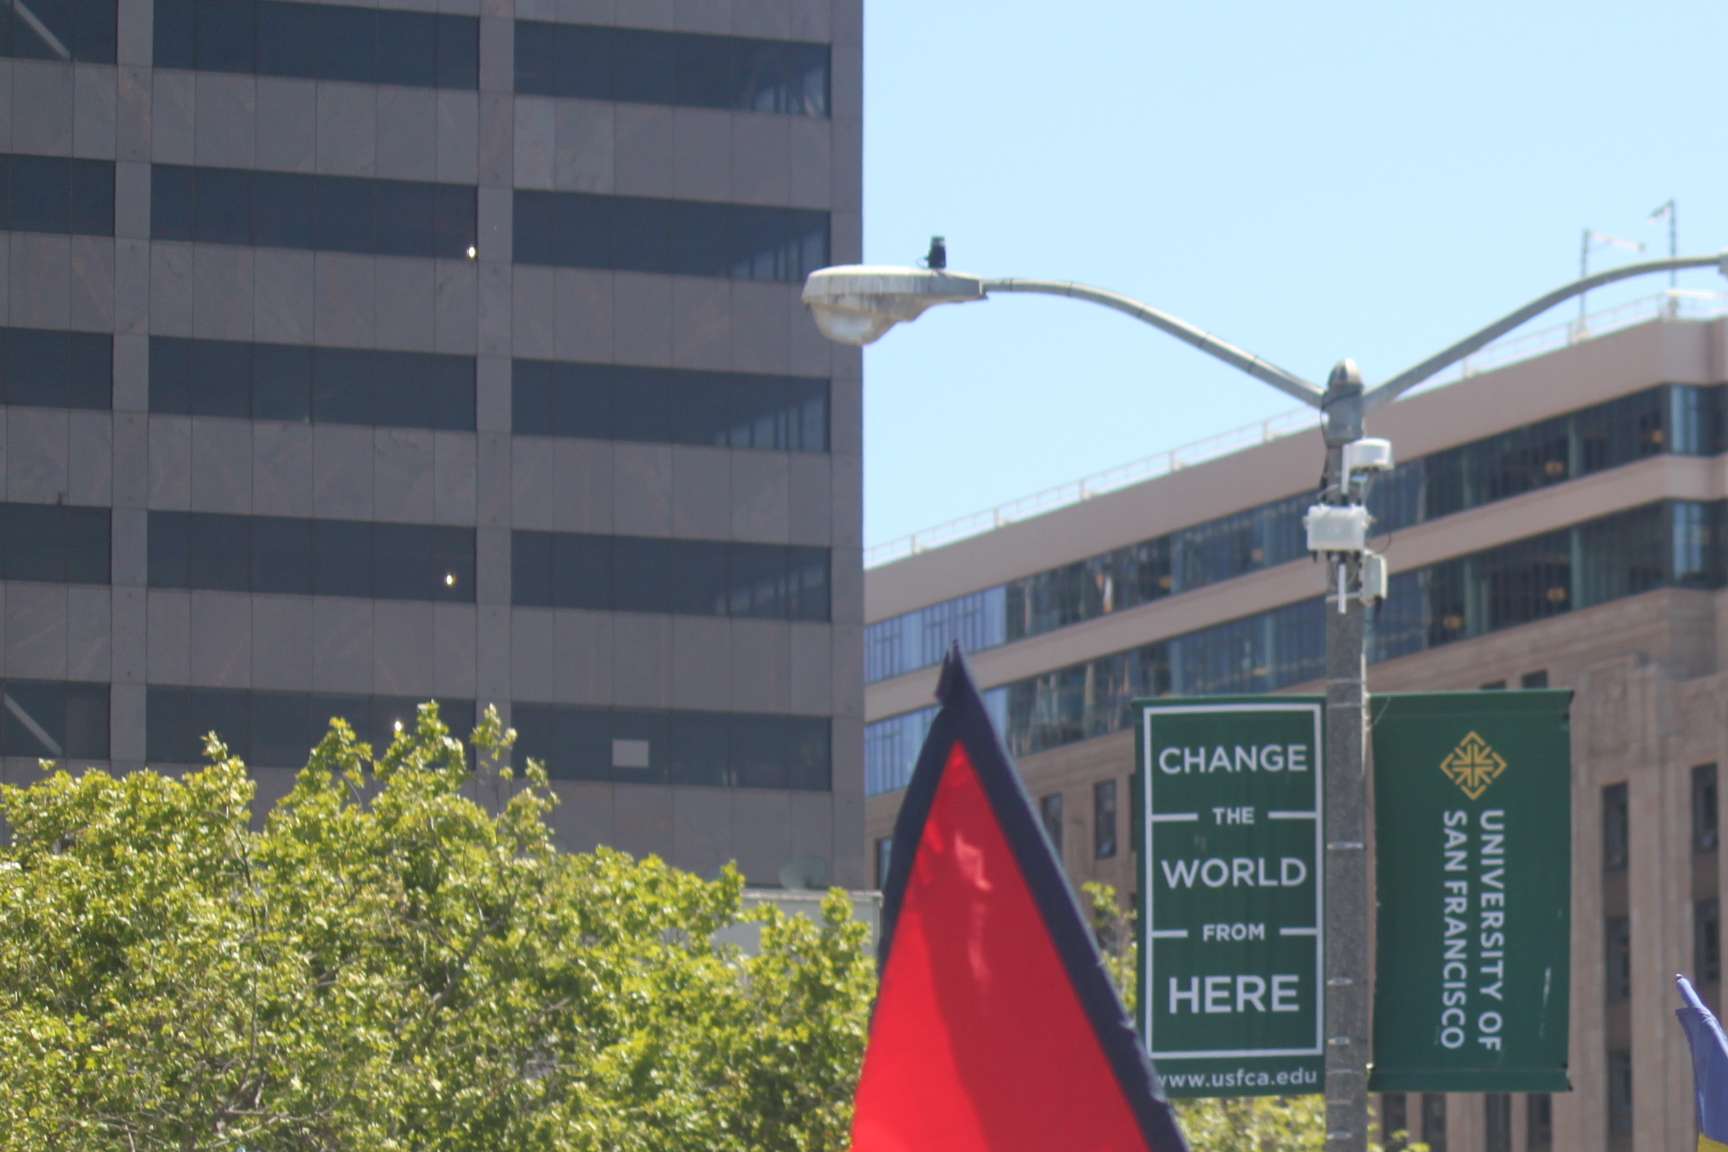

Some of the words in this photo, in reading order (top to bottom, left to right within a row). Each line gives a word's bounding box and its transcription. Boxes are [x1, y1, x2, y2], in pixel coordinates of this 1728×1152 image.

[1158, 744, 1308, 775] CHANGE
[1212, 807, 1255, 825] THE
[1443, 810, 1468, 872] SAN
[1161, 857, 1307, 889] WORLD
[1479, 809, 1505, 1001] UNIVERSITY
[1202, 923, 1265, 942] FROM
[1440, 880, 1468, 1049] FRANCISCO
[1168, 975, 1300, 1014] HERE
[1478, 1011, 1503, 1051] OF
